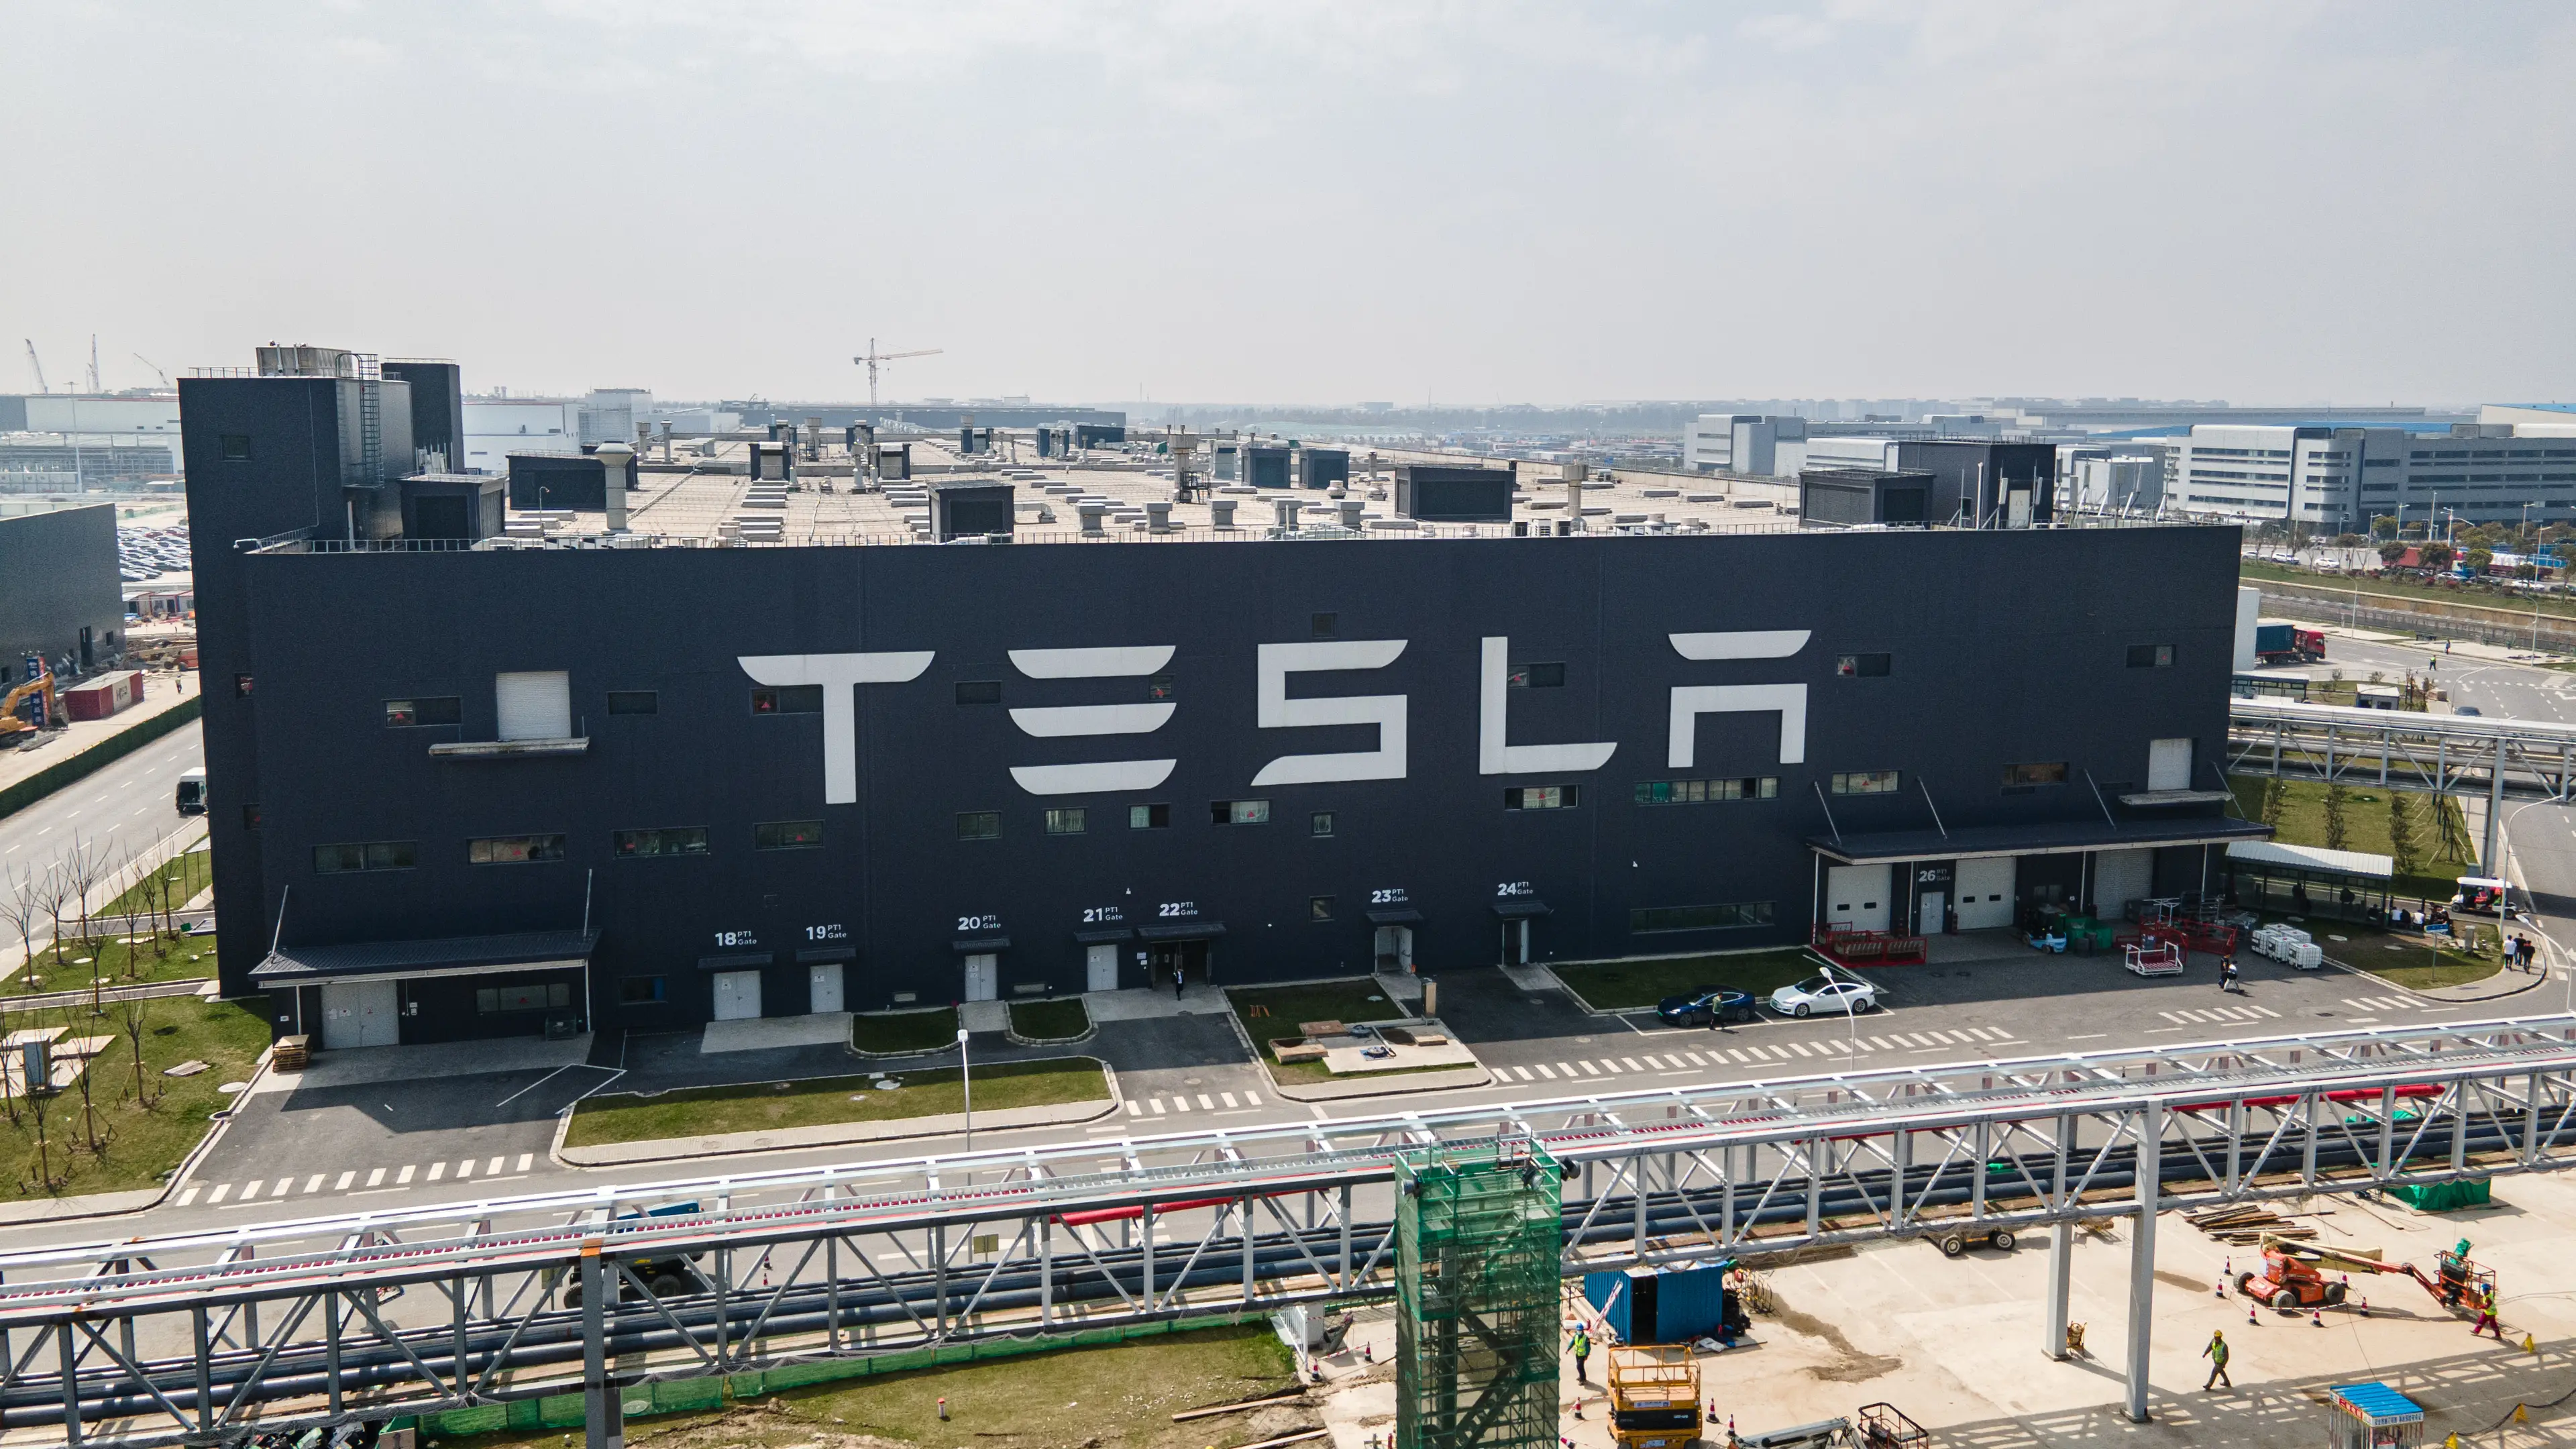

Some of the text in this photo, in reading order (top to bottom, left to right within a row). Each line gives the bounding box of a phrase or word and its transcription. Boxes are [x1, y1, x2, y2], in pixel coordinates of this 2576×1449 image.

[738, 631, 1811, 804] TESLA
[1918, 869, 1936, 882] 26
[1497, 882, 1517, 896] 24
[1371, 890, 1391, 903] 23
[1083, 908, 1103, 922] 21
[1159, 902, 1180, 916] 22
[957, 916, 981, 930] 20
[714, 932, 737, 947] 18
[806, 925, 826, 940] 19
